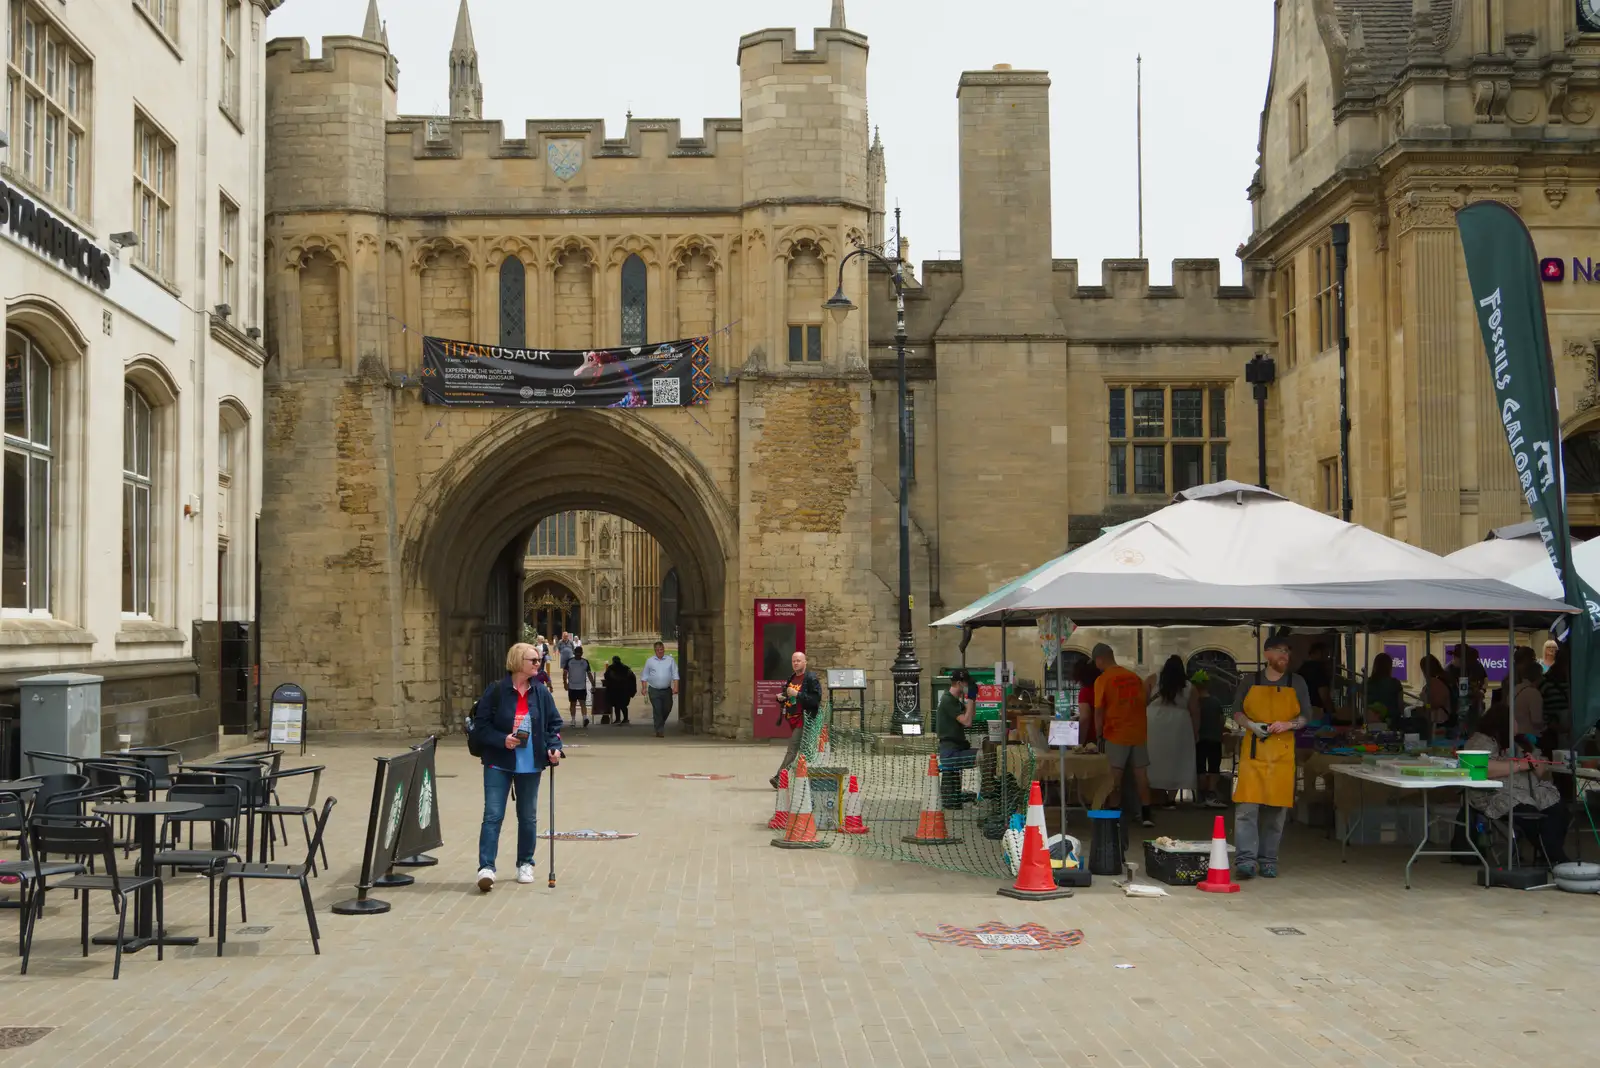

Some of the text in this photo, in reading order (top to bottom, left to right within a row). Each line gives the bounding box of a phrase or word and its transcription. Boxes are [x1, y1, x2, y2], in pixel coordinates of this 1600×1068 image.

[0, 180, 111, 289] STARBUCKS
[1479, 286, 1512, 391] FOSSILS
[1502, 397, 1539, 505] GALORE
[1477, 657, 1508, 669] West
